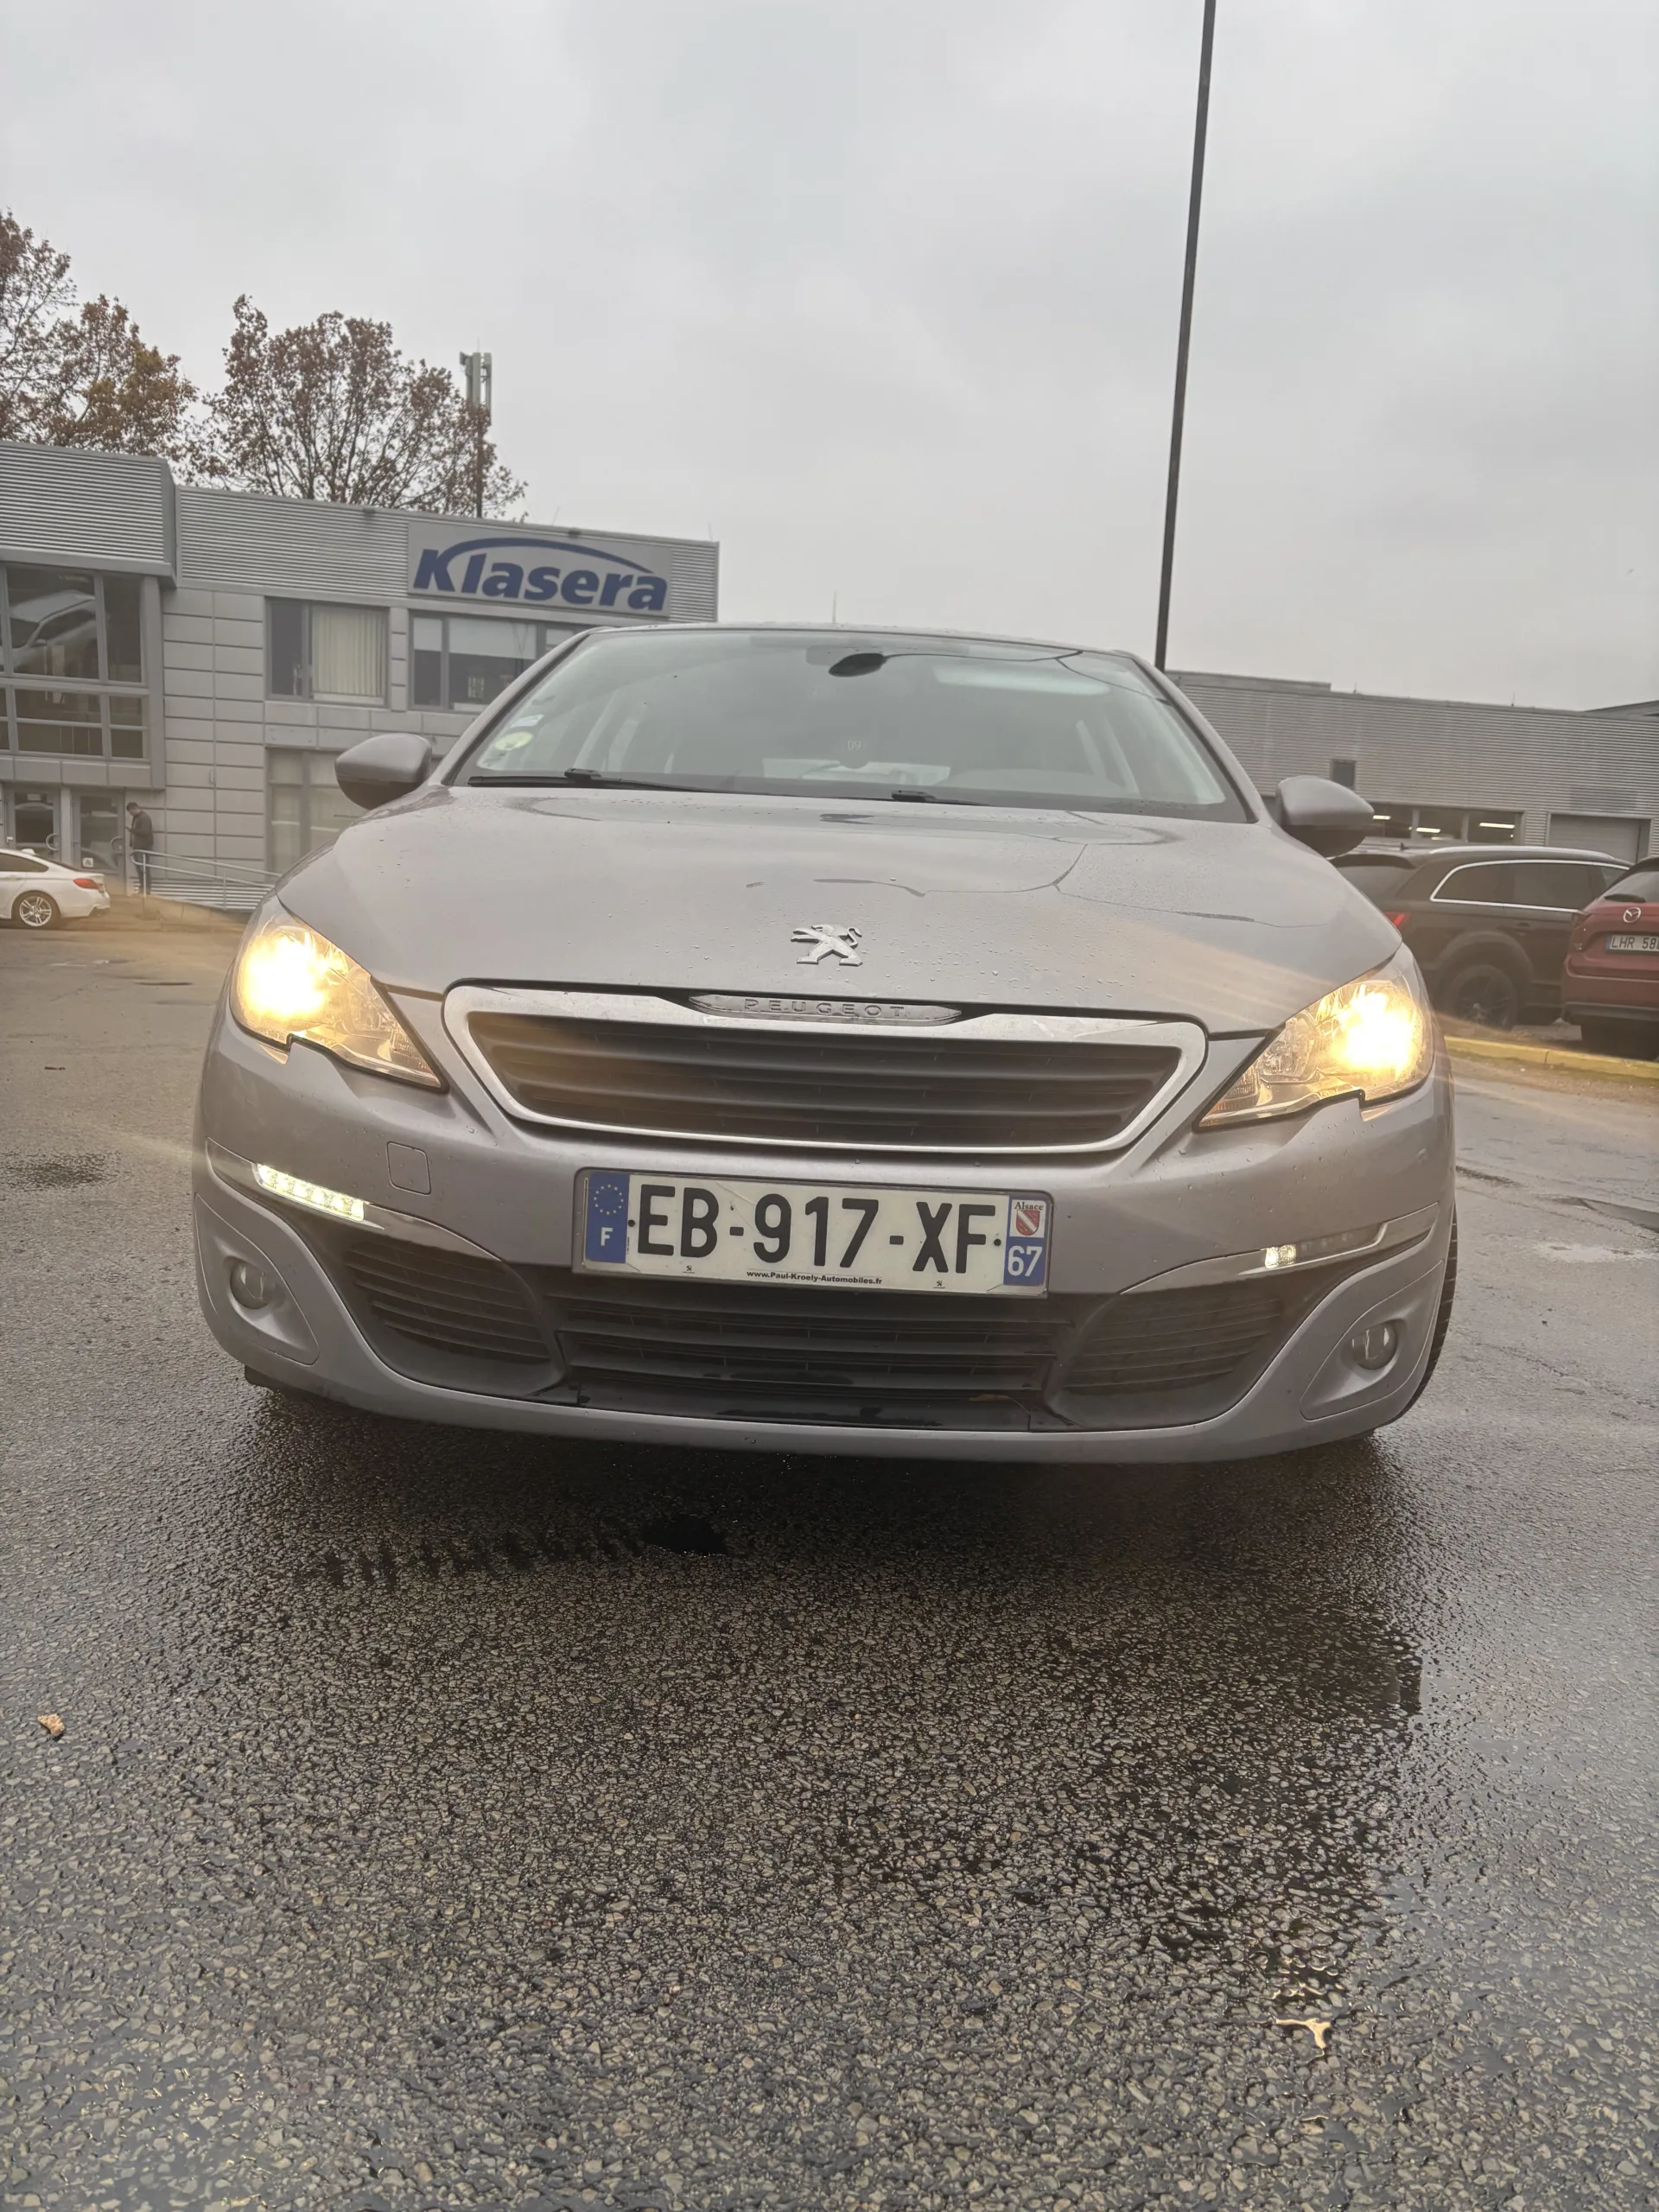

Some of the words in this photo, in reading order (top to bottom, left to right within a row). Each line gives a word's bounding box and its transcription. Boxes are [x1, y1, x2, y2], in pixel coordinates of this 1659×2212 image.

[413, 537, 668, 611] Klasera
[1611, 936, 1635, 949] LHR
[744, 998, 905, 1018] PEUGEOT
[1014, 1201, 1044, 1211] Alsace
[601, 1227, 613, 1246] F
[637, 1184, 996, 1274] EB-917-XF
[1007, 1245, 1043, 1276] 67
[747, 1271, 883, 1285] www.Paul-Kroely-Automobiles.fr
